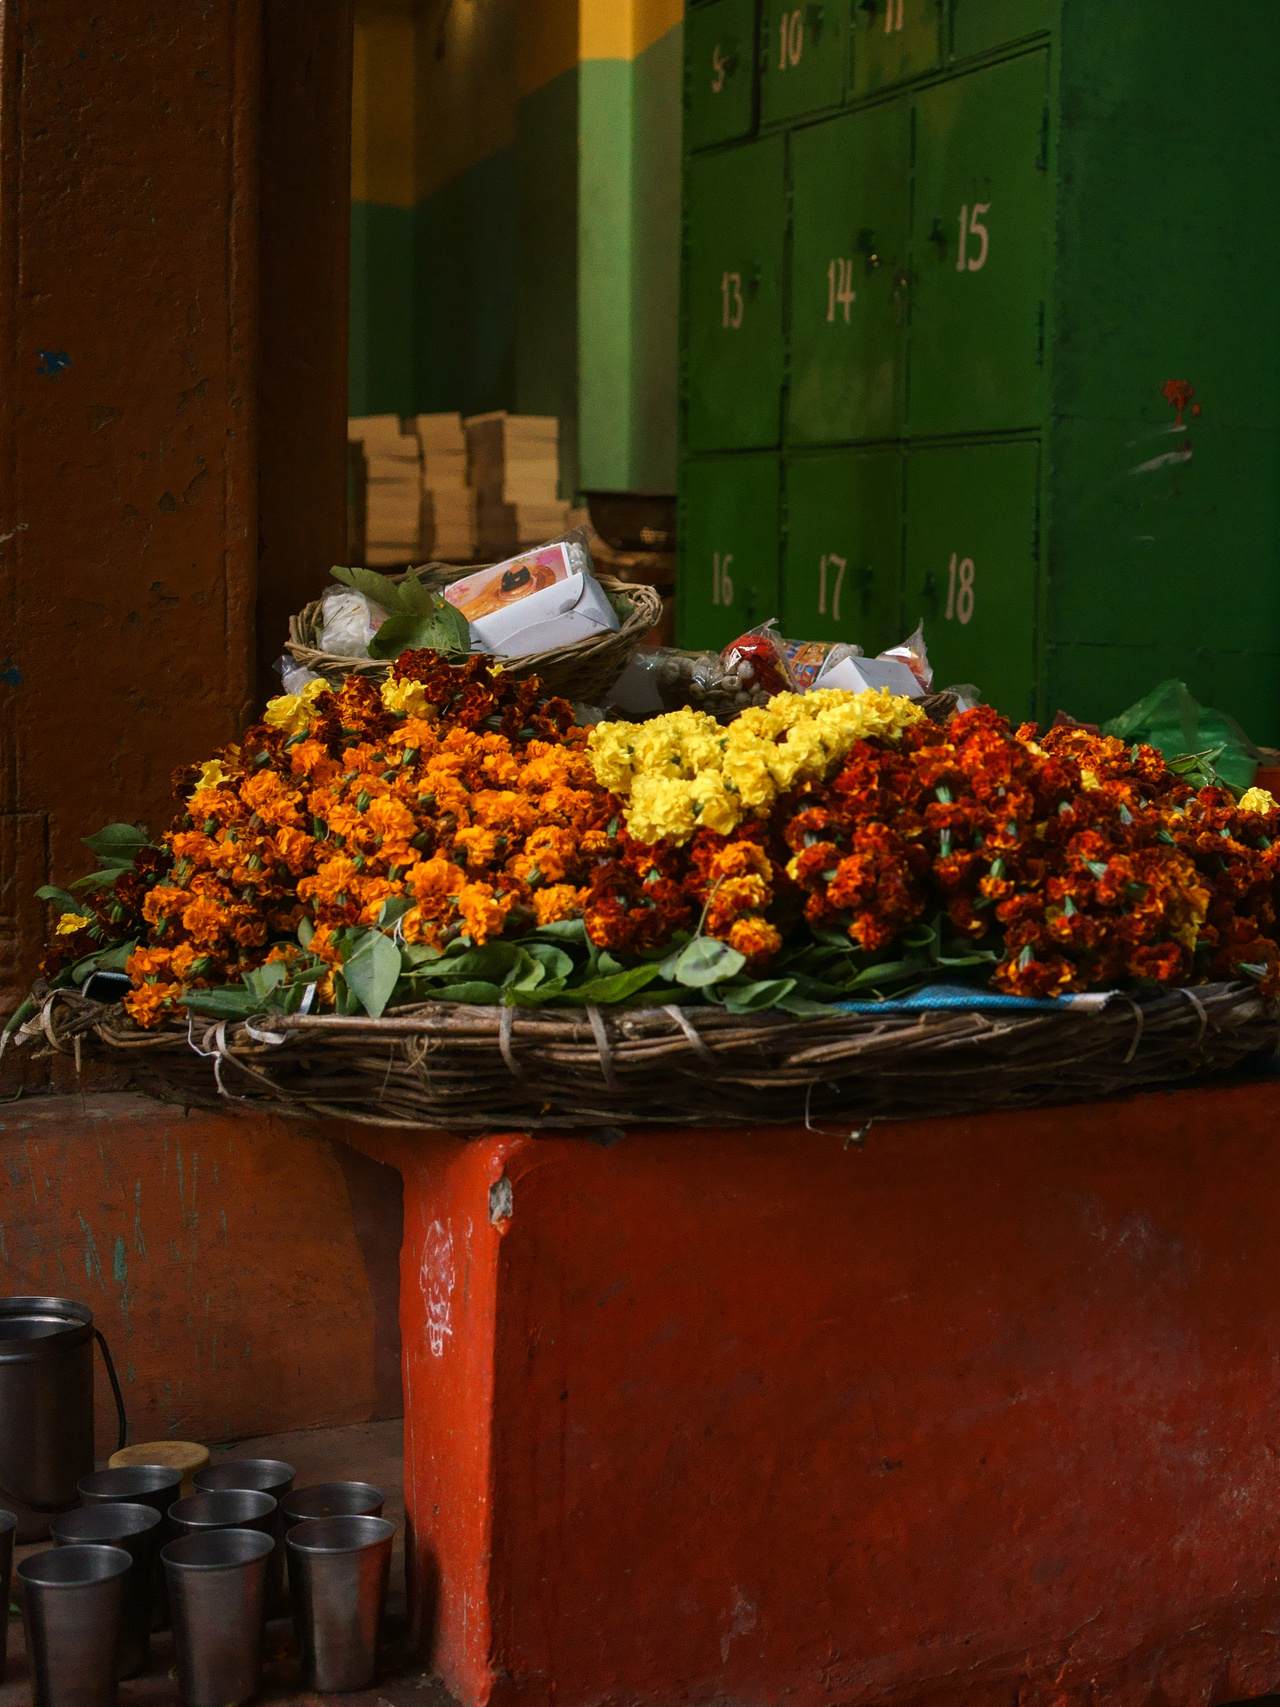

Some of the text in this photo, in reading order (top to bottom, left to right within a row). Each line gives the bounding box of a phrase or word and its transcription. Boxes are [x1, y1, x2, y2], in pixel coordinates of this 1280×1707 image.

[779, 10, 803, 70] 10
[956, 201, 991, 272] 15
[721, 271, 744, 329] 13
[826, 257, 856, 324] 14
[713, 551, 734, 607] 16
[818, 553, 847, 620] 17
[946, 552, 975, 625] 18
